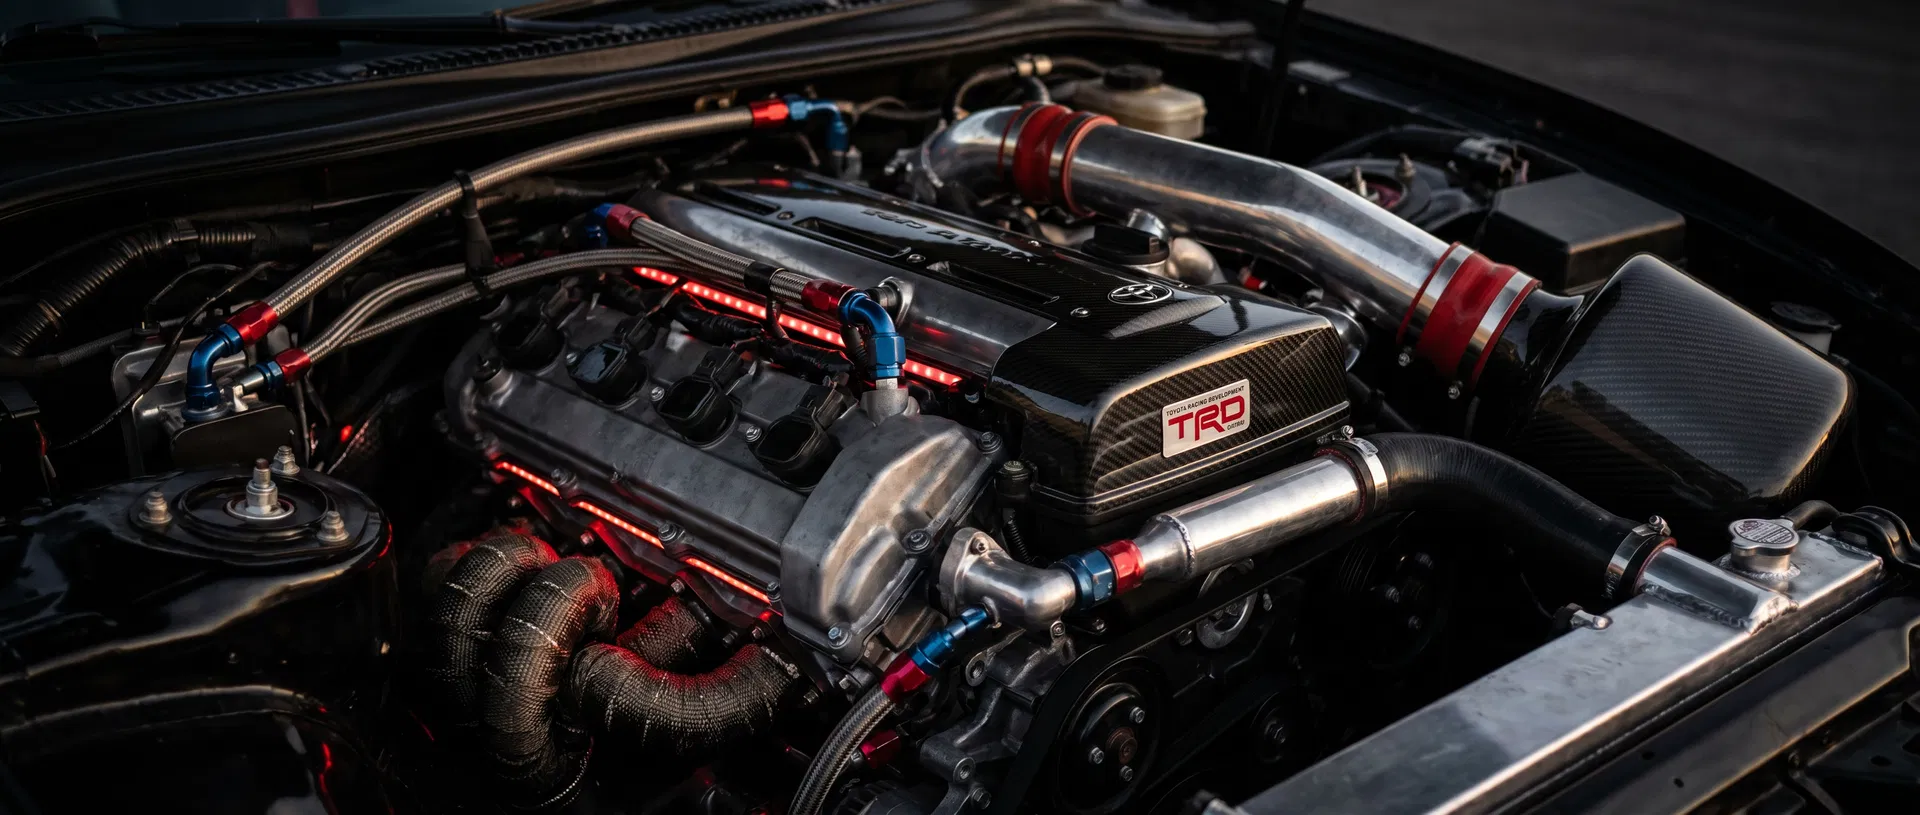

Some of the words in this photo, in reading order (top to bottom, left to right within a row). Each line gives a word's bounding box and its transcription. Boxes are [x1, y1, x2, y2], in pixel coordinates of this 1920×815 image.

[1166, 406, 1187, 416] TOYOTA
[1187, 398, 1208, 409] RACING
[1168, 395, 1245, 441] TRD
